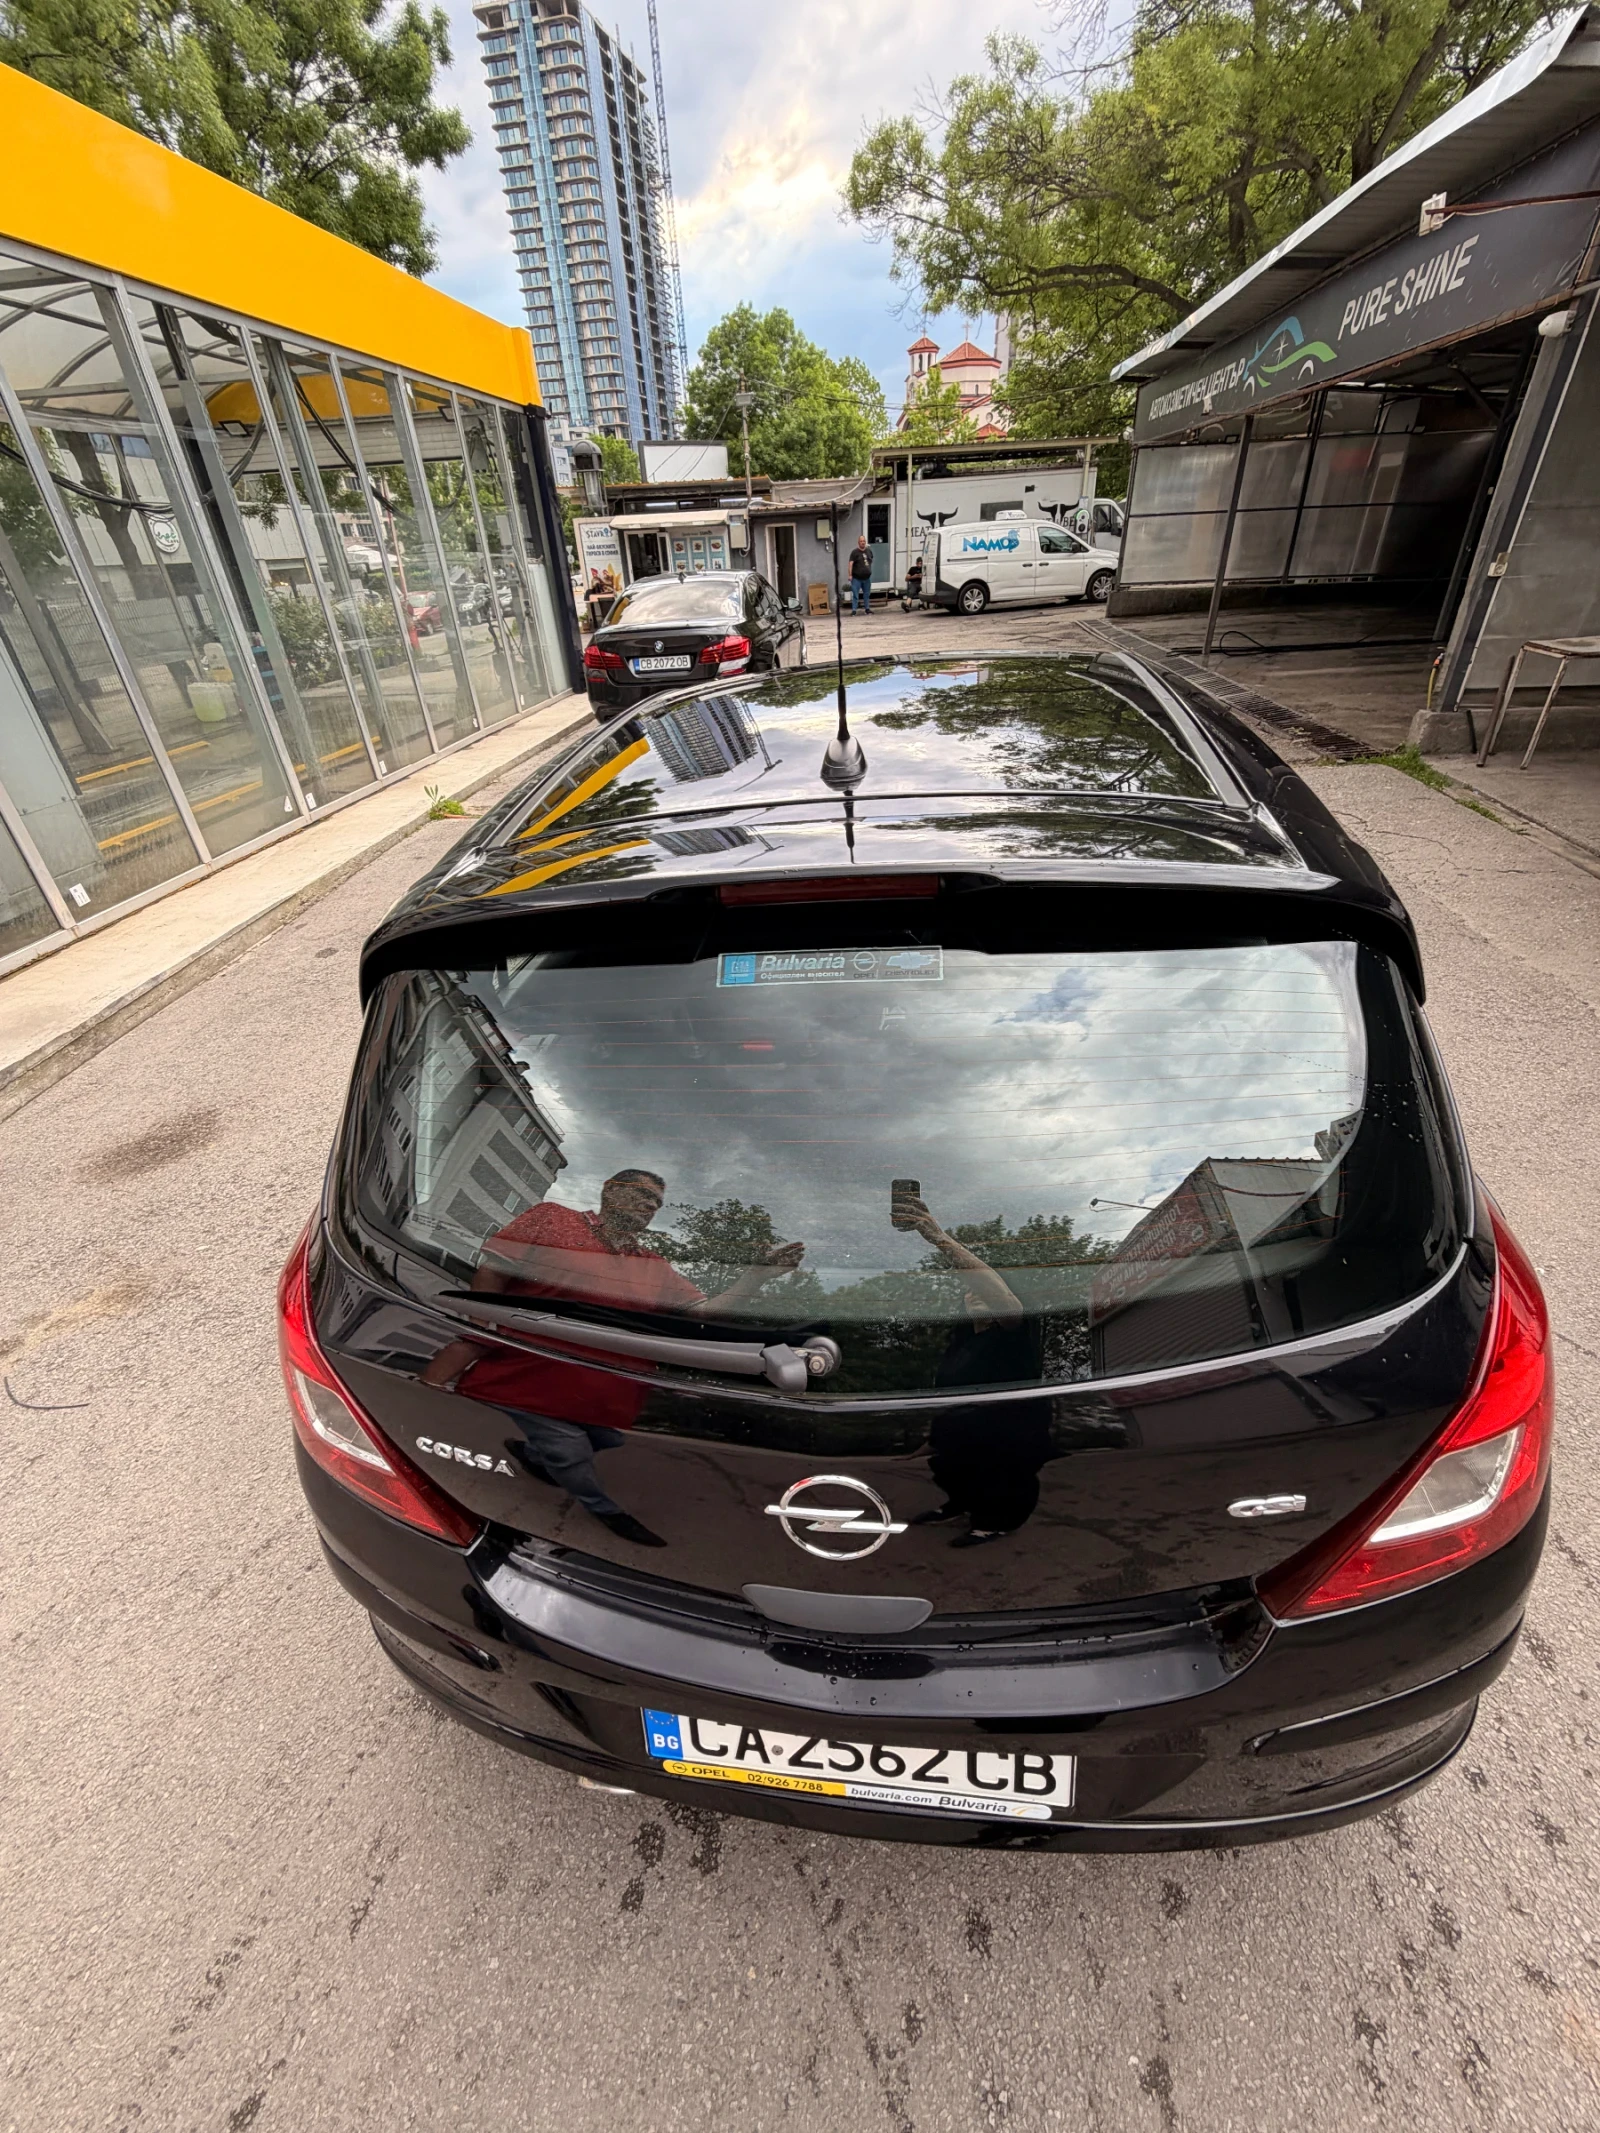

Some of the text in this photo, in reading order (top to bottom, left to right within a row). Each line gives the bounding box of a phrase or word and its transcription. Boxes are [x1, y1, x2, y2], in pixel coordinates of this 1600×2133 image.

[1337, 234, 1480, 341] PURE SHINE
[1148, 358, 1246, 421] АВТОКОЗМЕТИЧЕН ЦЕНТЪР
[641, 656, 688, 669] CB 2072 OB
[760, 953, 845, 972] Bulvaria
[416, 1437, 515, 1477] CORSA
[653, 1733, 679, 1749] BG
[691, 1767, 1007, 1813] OPEL 02/926 7788 bulvaria.com Bulvaria
